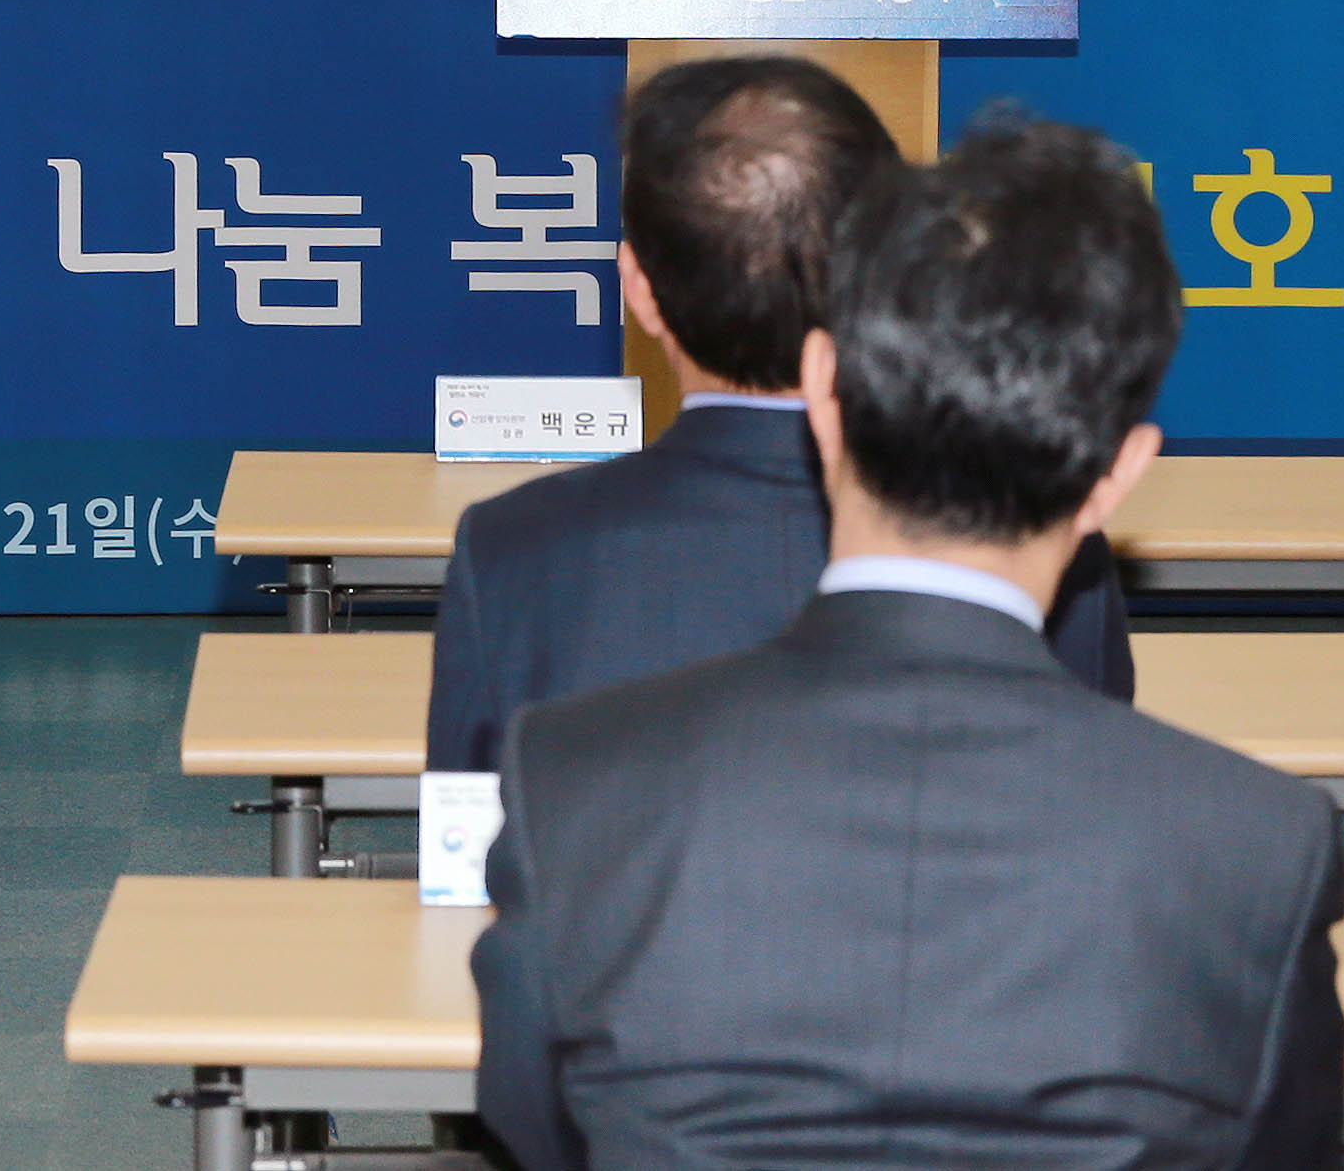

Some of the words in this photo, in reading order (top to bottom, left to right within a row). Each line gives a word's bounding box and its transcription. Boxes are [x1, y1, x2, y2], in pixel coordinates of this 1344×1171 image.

[46, 151, 382, 327] 나눔
[447, 148, 626, 330] 복
[541, 412, 628, 437] 백운규
[0, 494, 241, 568] 21일(수
